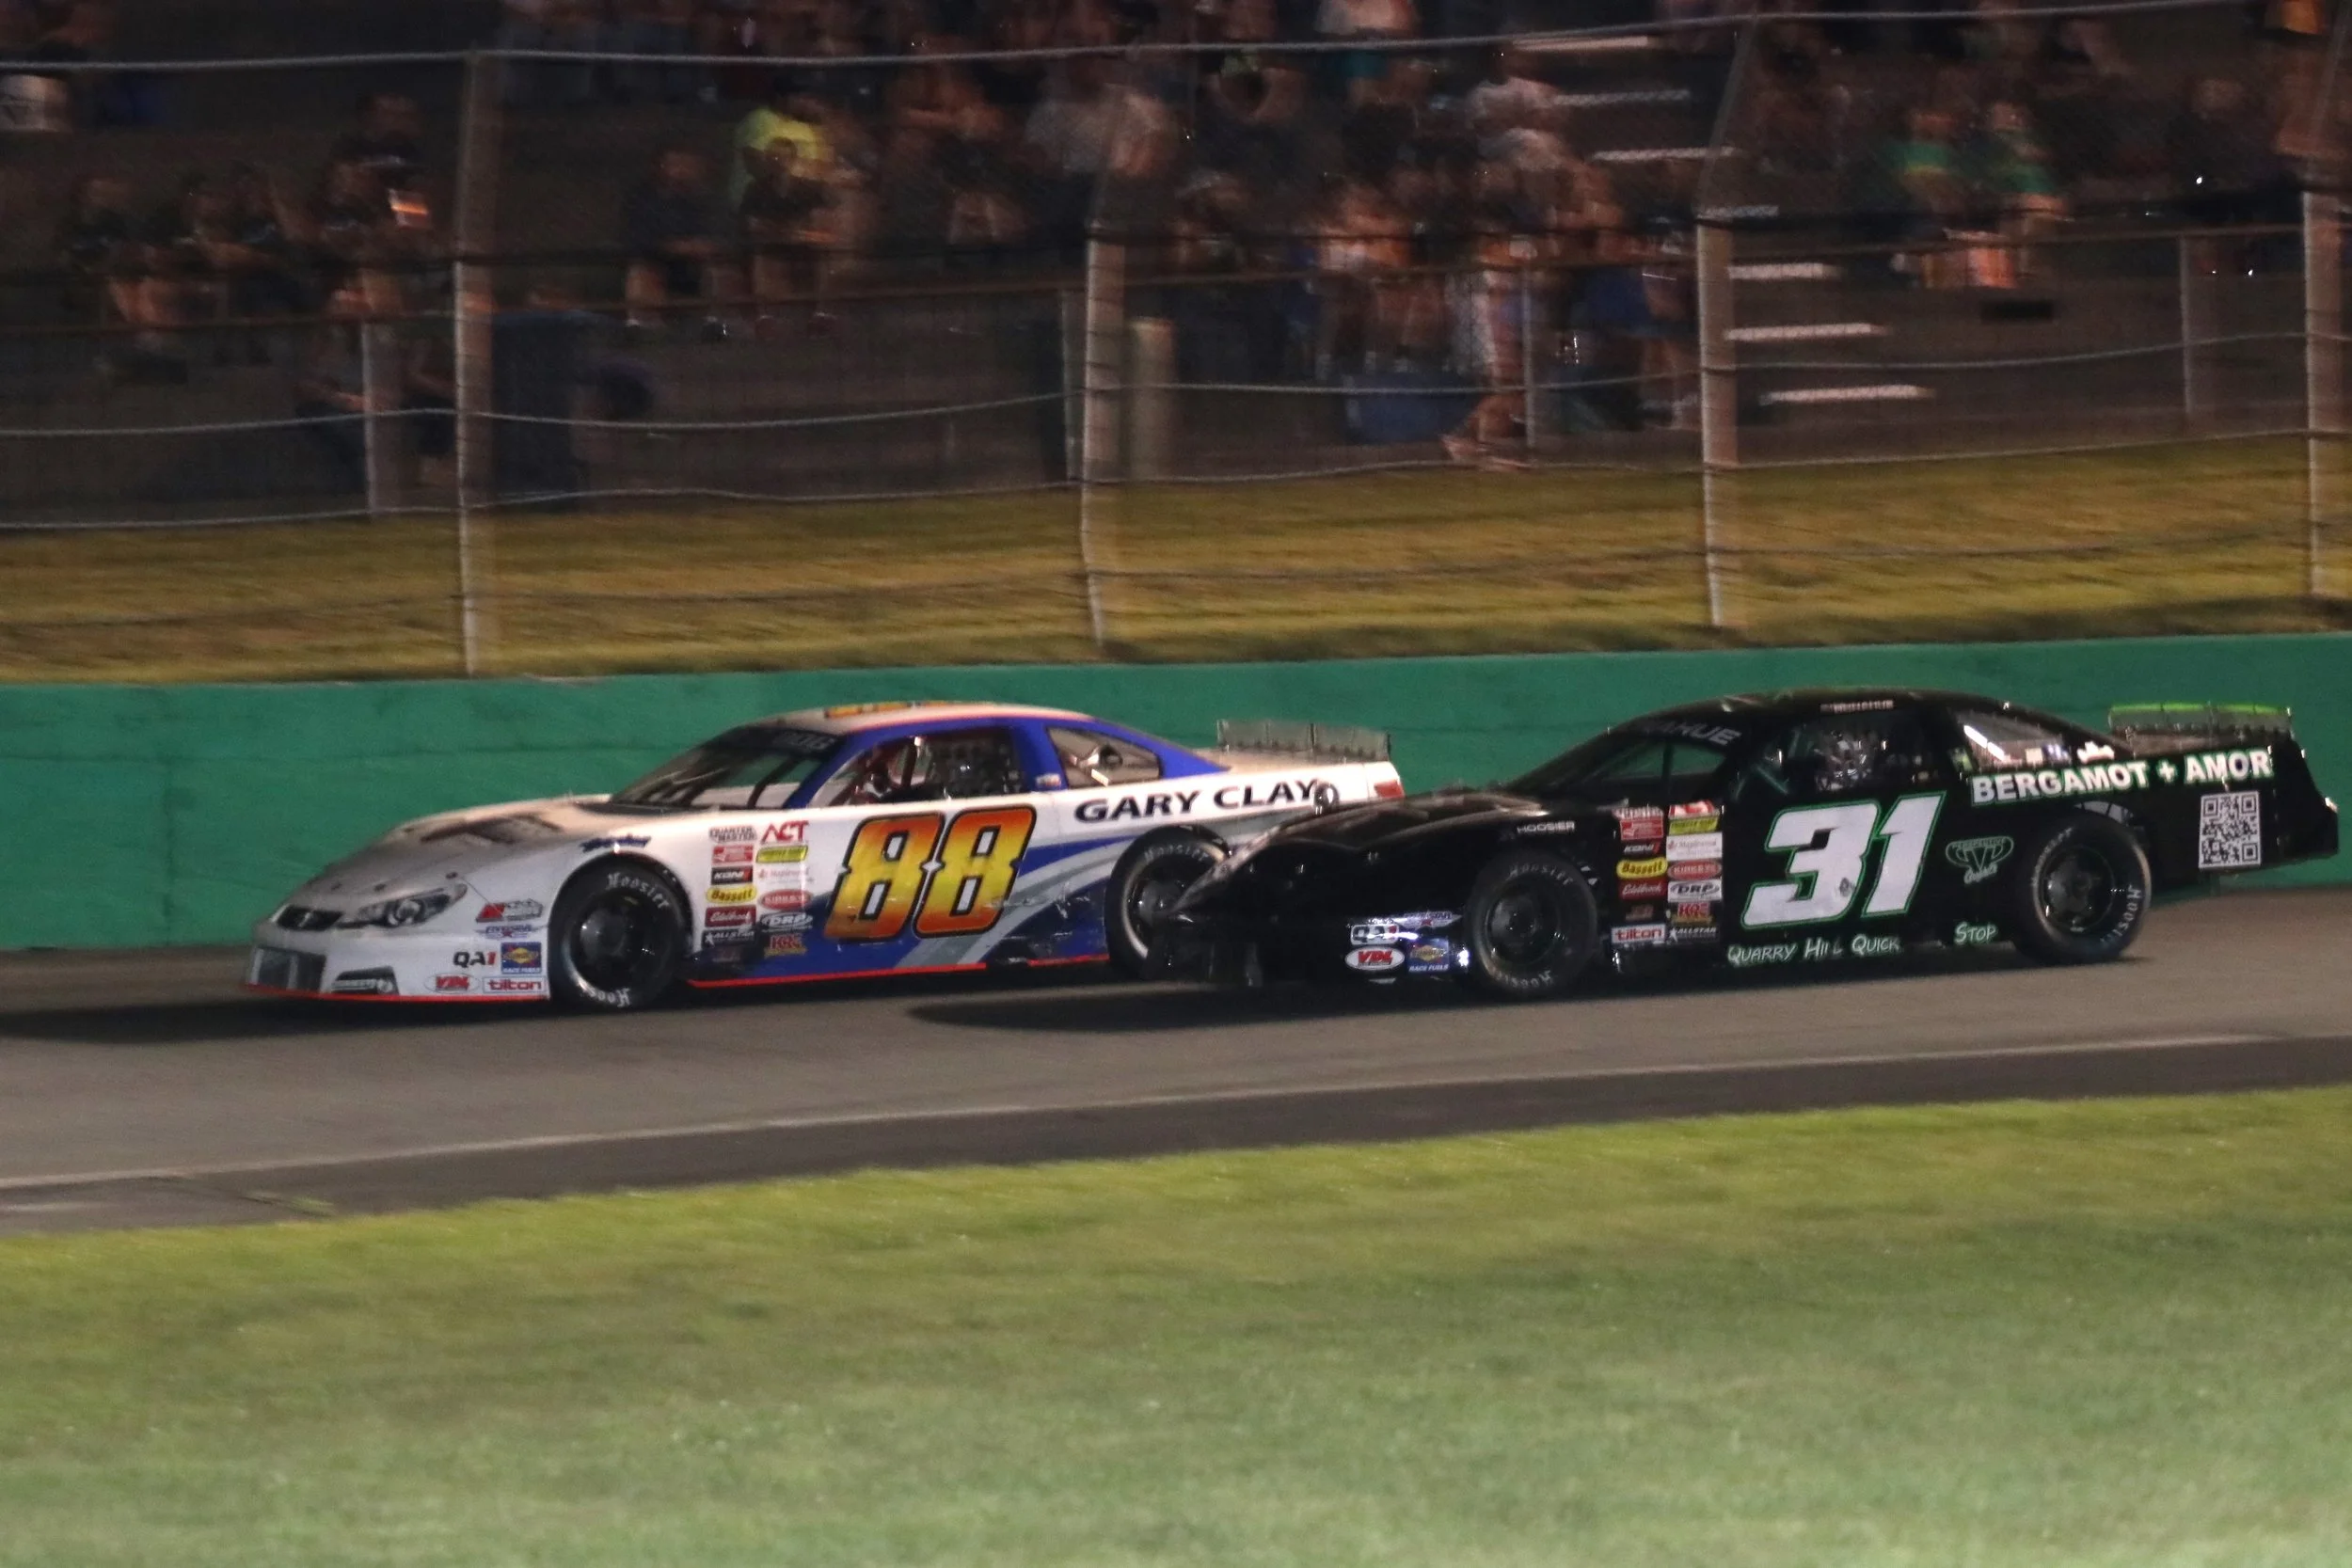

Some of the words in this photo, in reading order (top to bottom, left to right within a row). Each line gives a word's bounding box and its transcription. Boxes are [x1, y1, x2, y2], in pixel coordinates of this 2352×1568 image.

[1971, 761, 2148, 805] BERGAMOT
[2158, 760, 2178, 784] +
[2185, 750, 2273, 783] AMOR
[1074, 790, 1200, 823] GARY
[1213, 778, 1318, 810] CLAY
[760, 820, 809, 845] ACT
[1517, 821, 1575, 833] HOOSIER
[1621, 861, 1663, 874] Bassett
[1742, 792, 1946, 928] 31
[824, 803, 1036, 941] 88
[605, 871, 670, 909] Hoosier
[710, 889, 753, 901] Bassett
[1677, 884, 1715, 894] DRP
[1615, 927, 1662, 941] tilton
[453, 951, 497, 968] QA1
[488, 979, 542, 990] tilton
